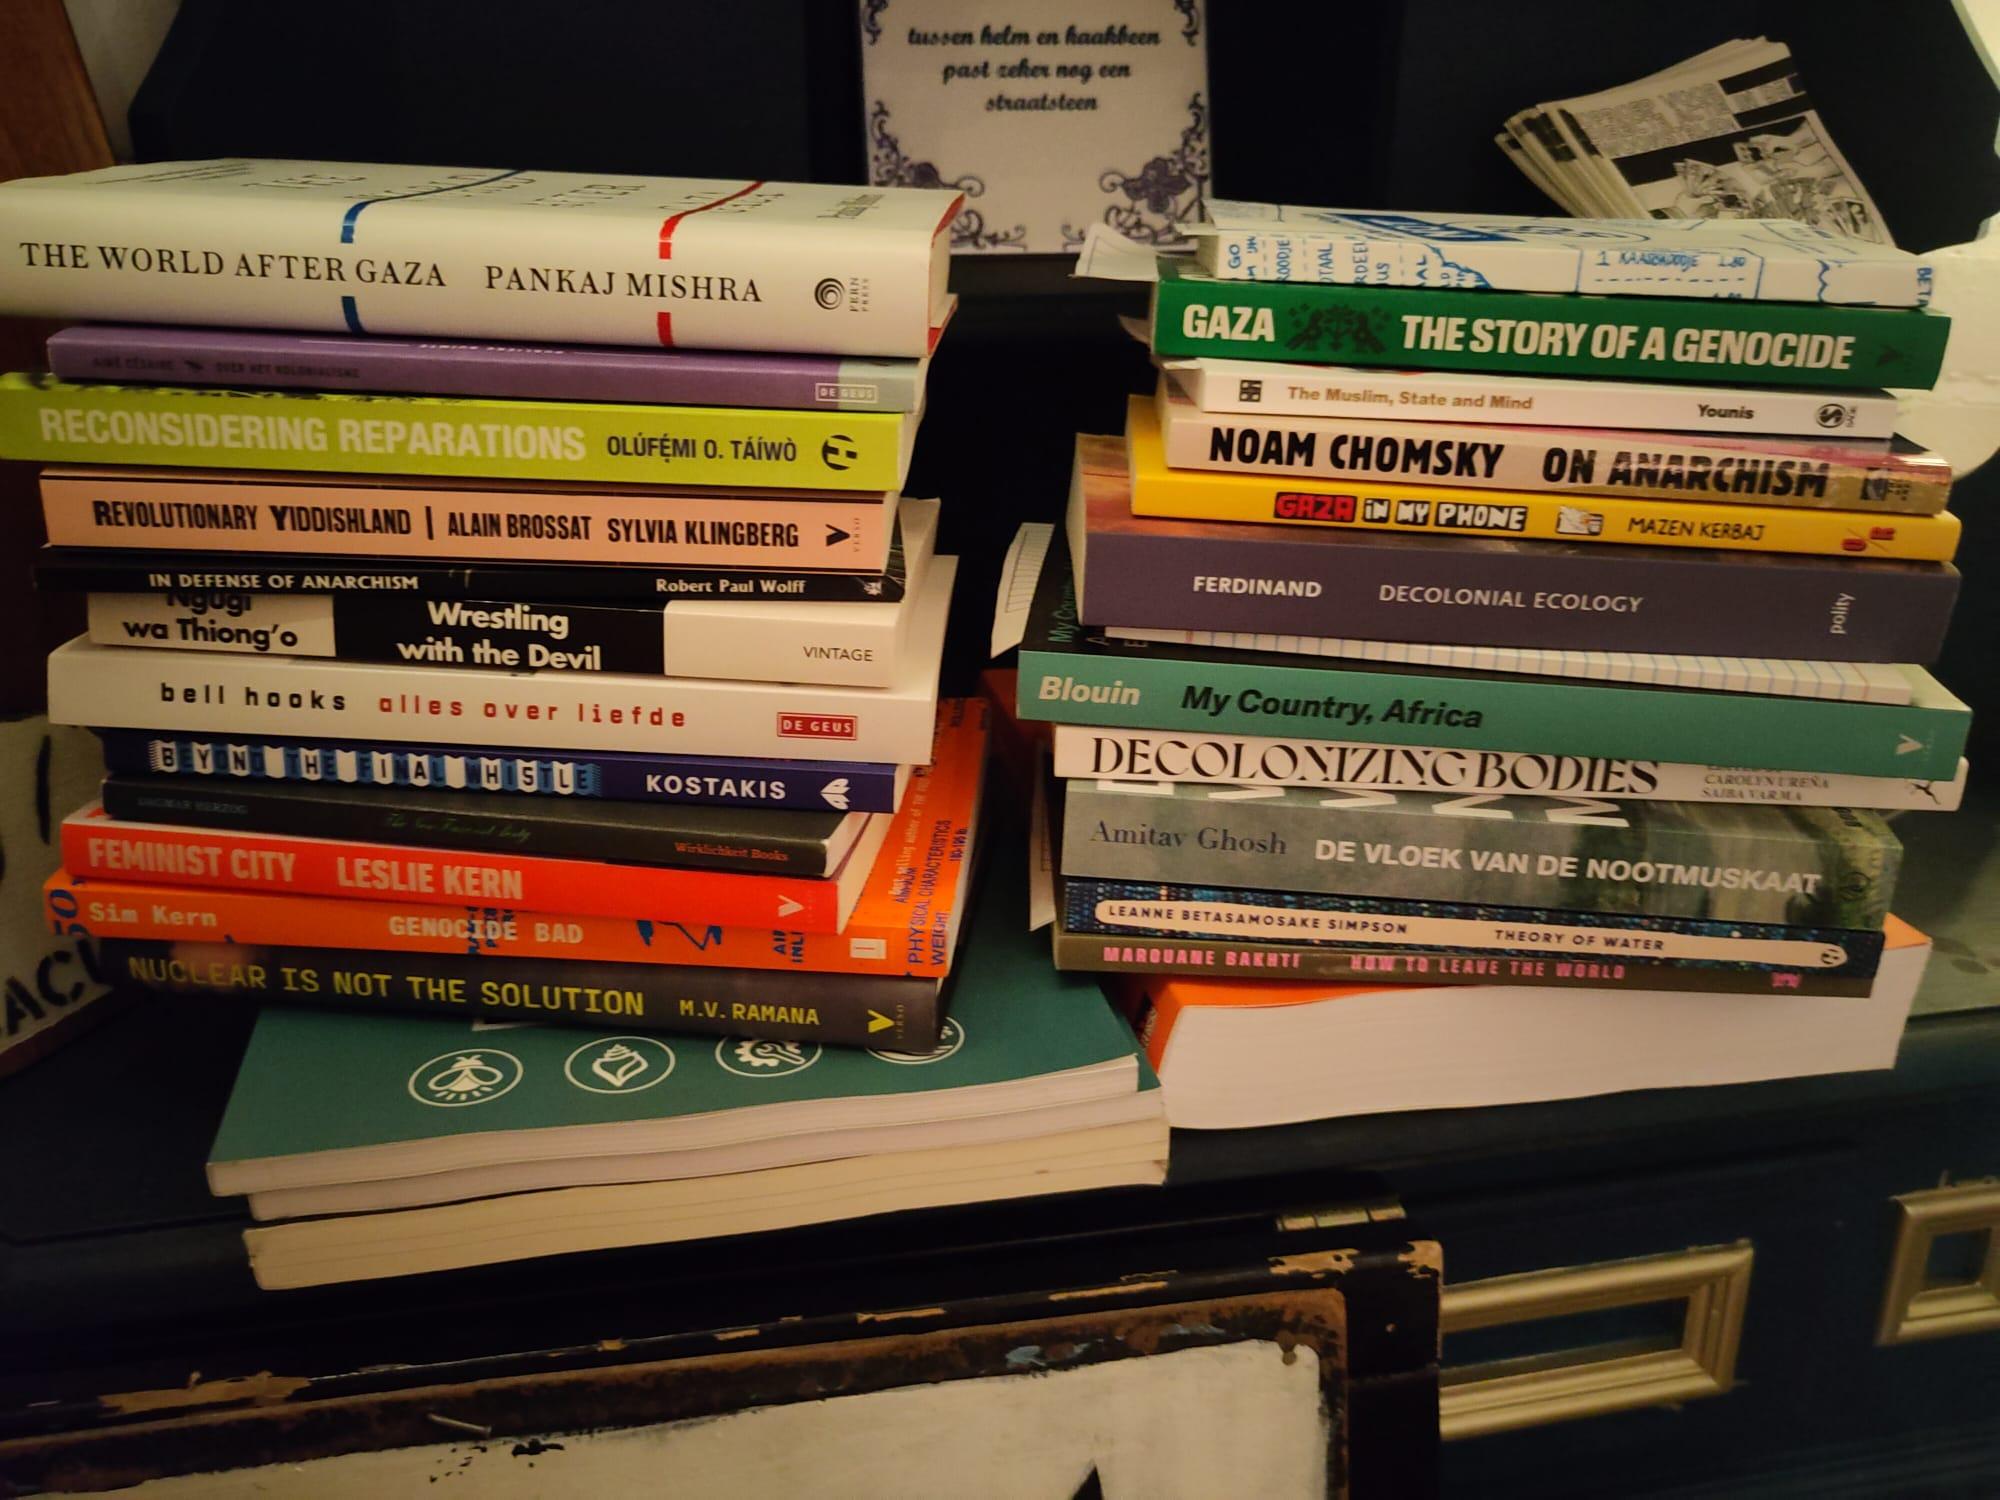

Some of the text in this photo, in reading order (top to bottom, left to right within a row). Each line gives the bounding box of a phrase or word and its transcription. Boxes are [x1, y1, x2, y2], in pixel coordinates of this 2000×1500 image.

[908, 26, 974, 46] tussen
[980, 23, 1030, 46] helm
[1036, 29, 1059, 46] en
[943, 60, 991, 85] past
[1056, 63, 1092, 85] nog
[1099, 63, 1131, 79] een
[986, 94, 1098, 112] straatsteen
[20, 242, 446, 287] THE WORLD AFTER GAZA
[485, 265, 762, 302] PANKAJ MISHRA
[1183, 304, 1856, 371] GAZA THE STORY OF A GENOCIDE
[1288, 386, 1534, 411] The Muslim, State and Mind
[1698, 402, 1754, 421] Younis
[40, 406, 586, 461] RECONSIDERING REPARATIONS
[703, 440, 723, 461] O.
[1209, 426, 1316, 468] NOAM
[1329, 434, 1505, 479] CHOMSKY
[1542, 446, 1597, 485] ON
[1607, 451, 1830, 498] ANARCHISM
[93, 500, 412, 535] REVOLUTIONARY YIDDISHLAND
[448, 512, 591, 541] ALAIN BROSSAT
[1275, 492, 1357, 522] GAZA
[1396, 500, 1429, 526] MY
[1435, 502, 1528, 532] PHONE
[607, 517, 799, 548] SYLVIA KLINGBERG
[1629, 516, 1766, 542] MAZEN KERBAJ
[149, 572, 419, 590] IN DEFENSE OF ANARCHISM
[656, 578, 806, 595] Robert Paul Wolff
[1193, 575, 1323, 599] FERDINAND
[1379, 583, 1643, 613] DECOLONIAL ECOLOGY
[428, 600, 569, 640] Wrestling
[1829, 593, 1856, 636] polity
[123, 622, 168, 641] wa
[397, 637, 601, 671] with the Devil
[803, 646, 873, 662] VINTAGE
[161, 682, 686, 728] bell hooks alles over liefde
[1038, 675, 1484, 729] Blouin My Country, Africa
[783, 718, 853, 734] DE GEUS
[161, 747, 265, 774] BEYOND
[287, 749, 337, 776] THE
[466, 756, 588, 791] WHISTLE
[1091, 737, 1658, 797] DECOLONIZING BODIES
[646, 774, 786, 800] KOSTAKIS
[1091, 820, 1287, 855] Amitav Ghosh
[89, 837, 523, 900] FEMINIST CITY LESLIE KERN
[1315, 839, 1821, 895] DE VLOEK VAN DE NOOTMUSKAAT
[90, 902, 138, 924] Sim
[153, 906, 217, 927] Kern
[389, 915, 518, 941] GENOCIDE
[535, 922, 584, 944] BAD
[1108, 904, 1408, 935] LEANNE BETASAMOSAKE SIMPSON
[907, 899, 931, 965] PHYSICAL
[1494, 928, 1665, 951] THEORY OF WATER
[1103, 946, 1301, 970] MAROUANE BAKHTI
[1350, 954, 1626, 980] HOW TO LEAVE THE WORLD
[128, 956, 644, 1016] NUCLEAR IS NOT THE SOLUTION
[733, 1003, 820, 1026] RAMANA
